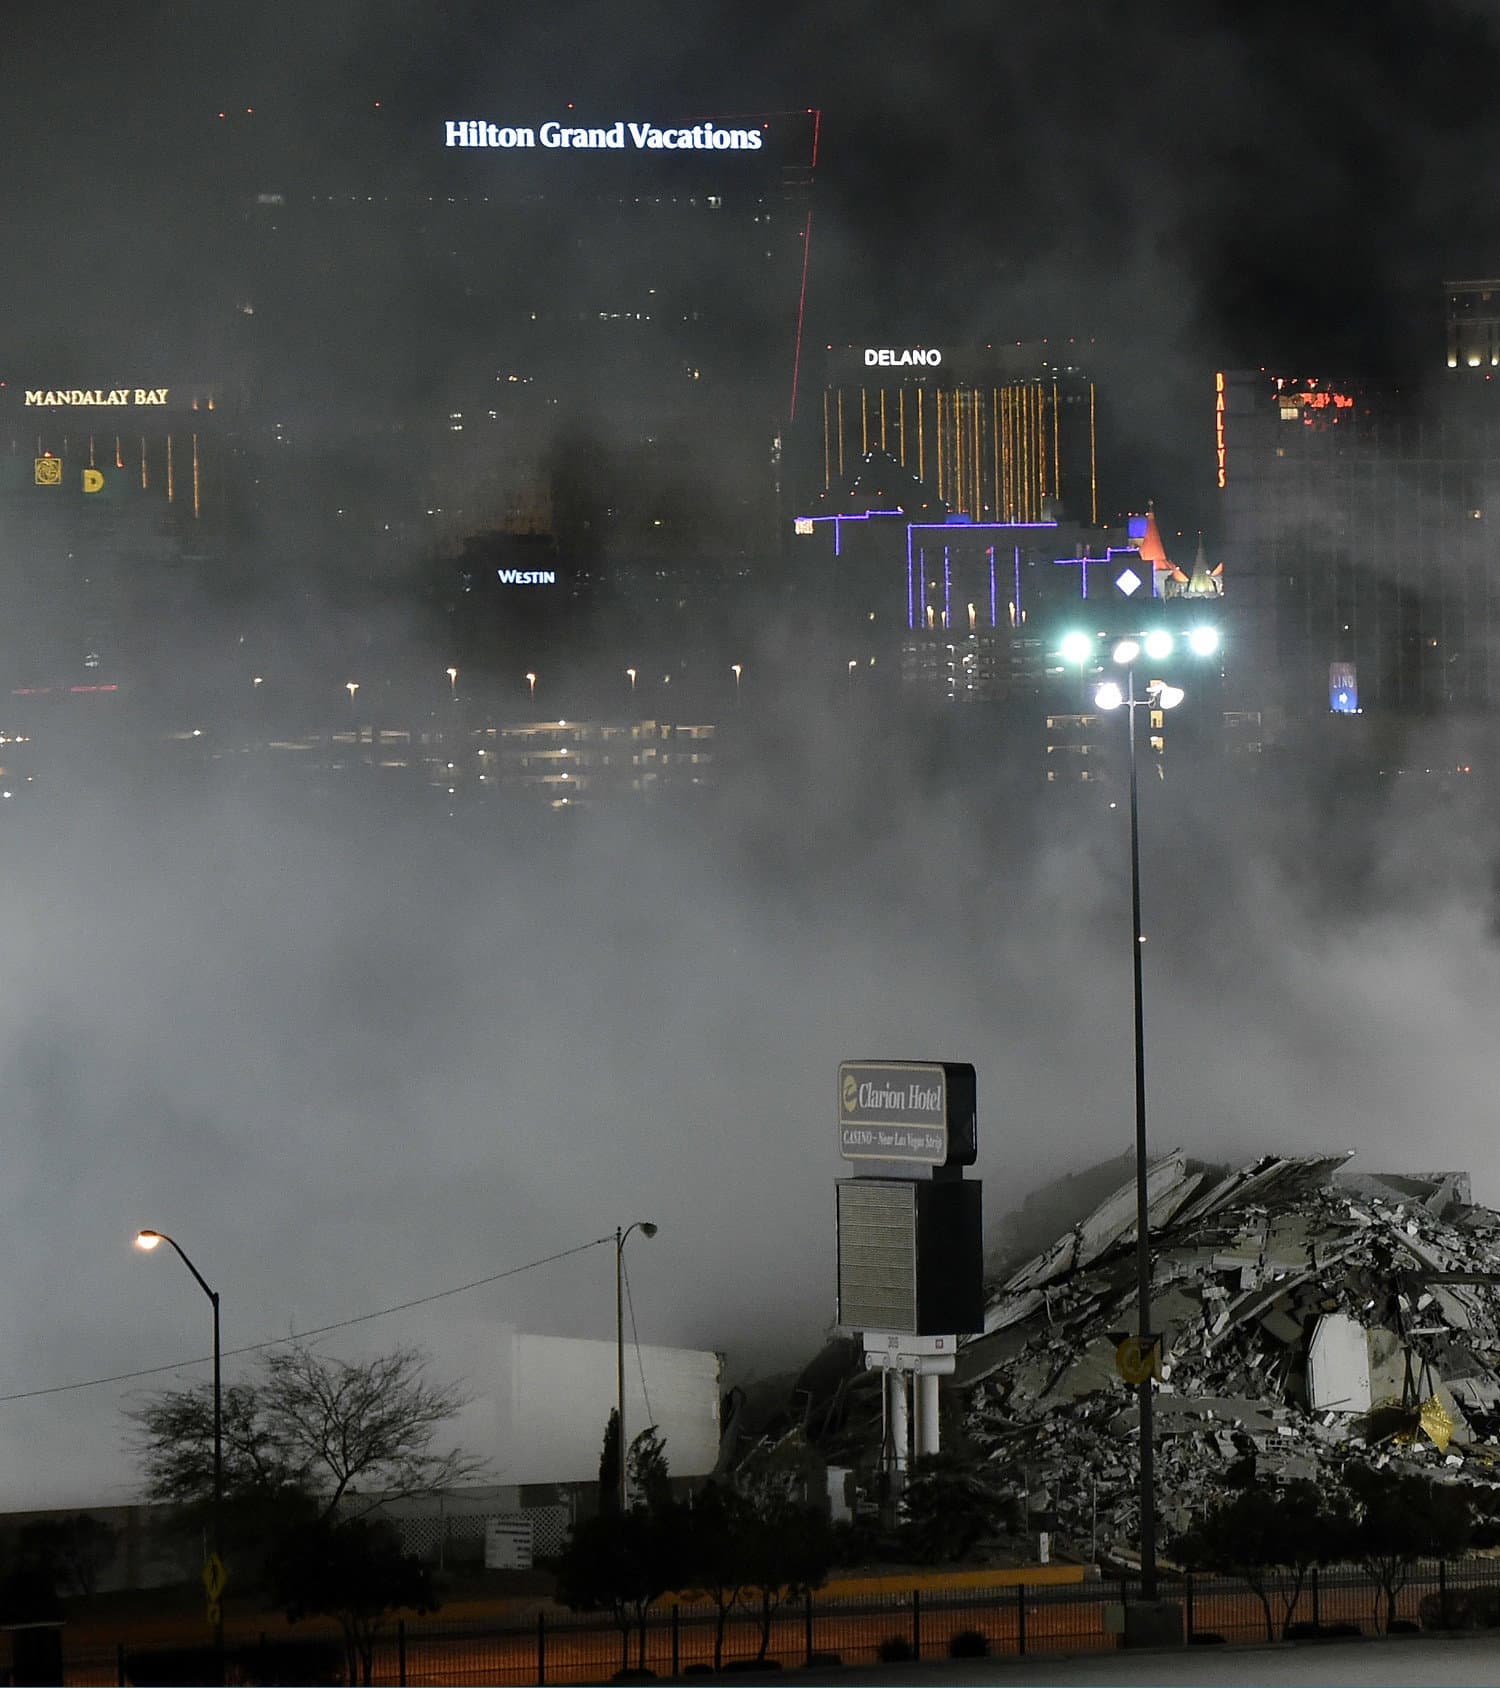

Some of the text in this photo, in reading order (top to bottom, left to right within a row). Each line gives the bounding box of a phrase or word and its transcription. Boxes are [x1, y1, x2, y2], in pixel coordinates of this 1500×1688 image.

[445, 121, 762, 150] Hilton Grand Vacations
[864, 348, 942, 367] DELANO
[24, 388, 169, 406] MANDALAY BAY
[1215, 372, 1225, 488] BALLYS
[859, 1081, 942, 1111] Clarion Hotel
[843, 1130, 872, 1145] CASINO
